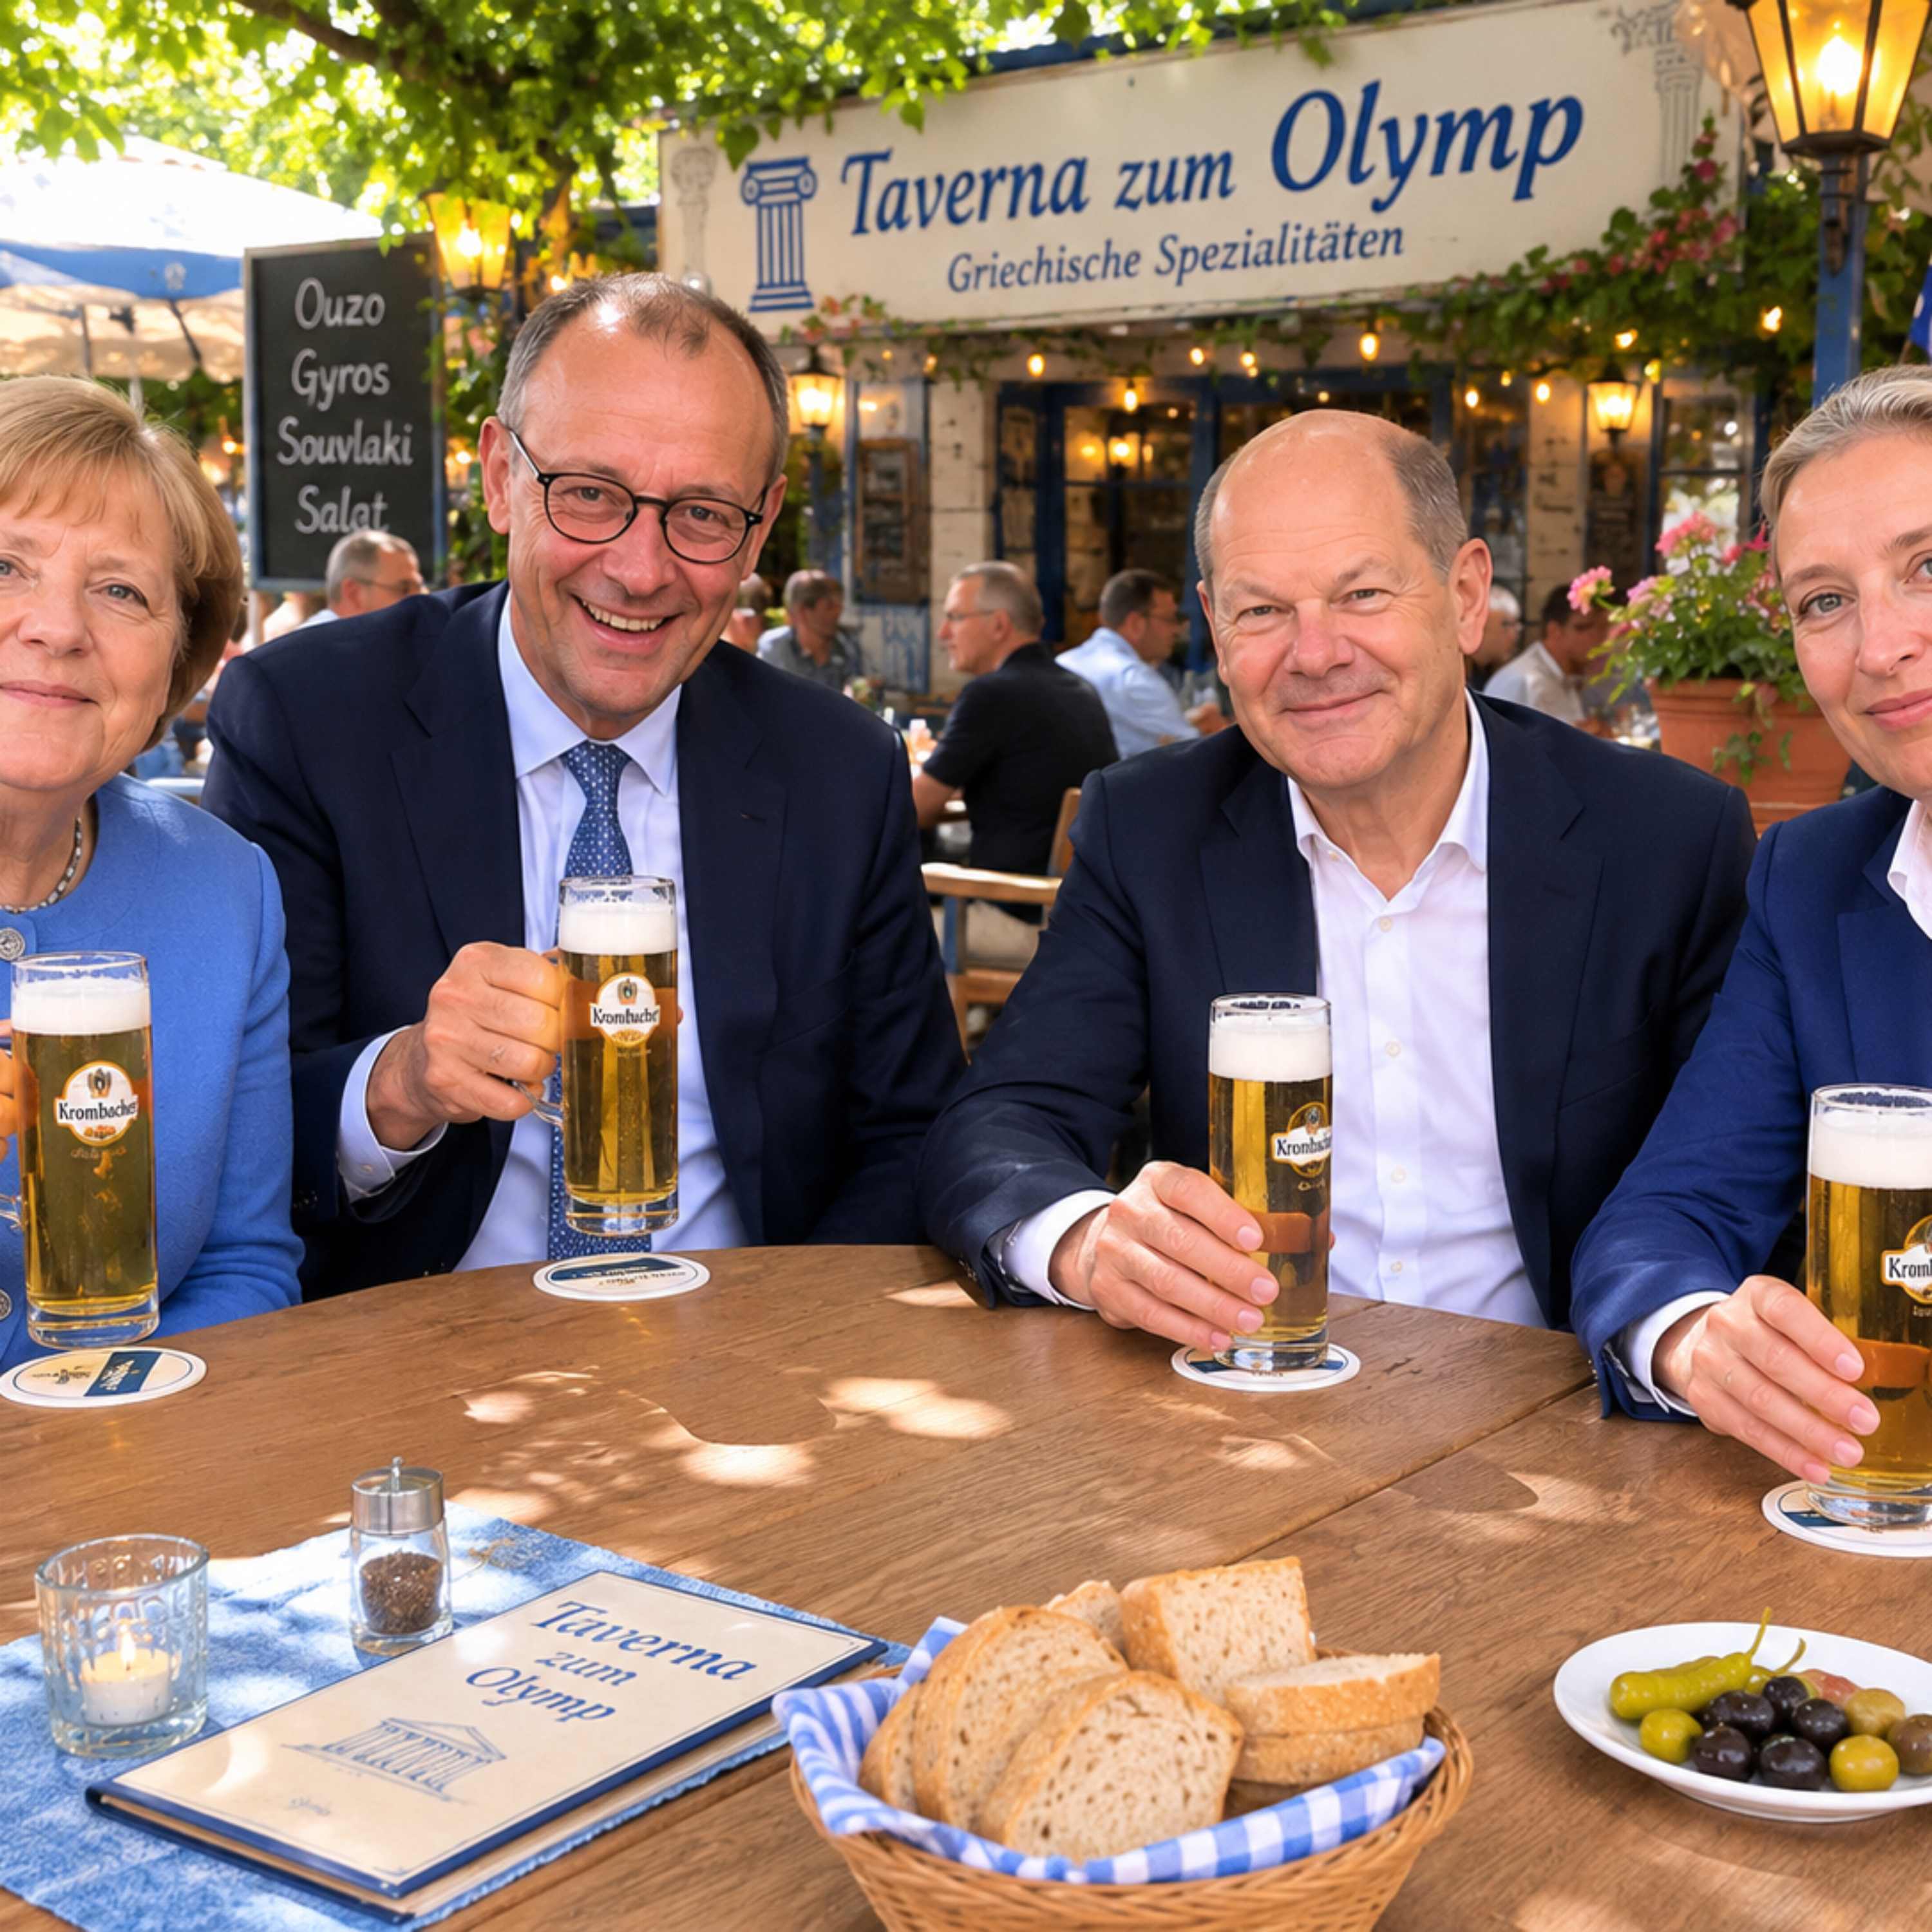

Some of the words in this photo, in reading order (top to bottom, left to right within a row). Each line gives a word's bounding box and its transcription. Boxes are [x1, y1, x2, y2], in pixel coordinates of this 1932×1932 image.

[840, 147, 1090, 235] Taverna
[1114, 150, 1235, 211] zum
[1271, 80, 1584, 214] Olymp
[948, 239, 1142, 293] Griechische
[1155, 220, 1404, 287] Spezialitäten
[294, 277, 386, 330] Ouzo
[290, 348, 390, 412] Gyros
[277, 415, 413, 466] Souvlaki
[294, 484, 390, 534] Salat
[530, 1600, 757, 1680] Taverna
[465, 1666, 616, 1723] Olymp
[534, 1651, 638, 1687] zum
